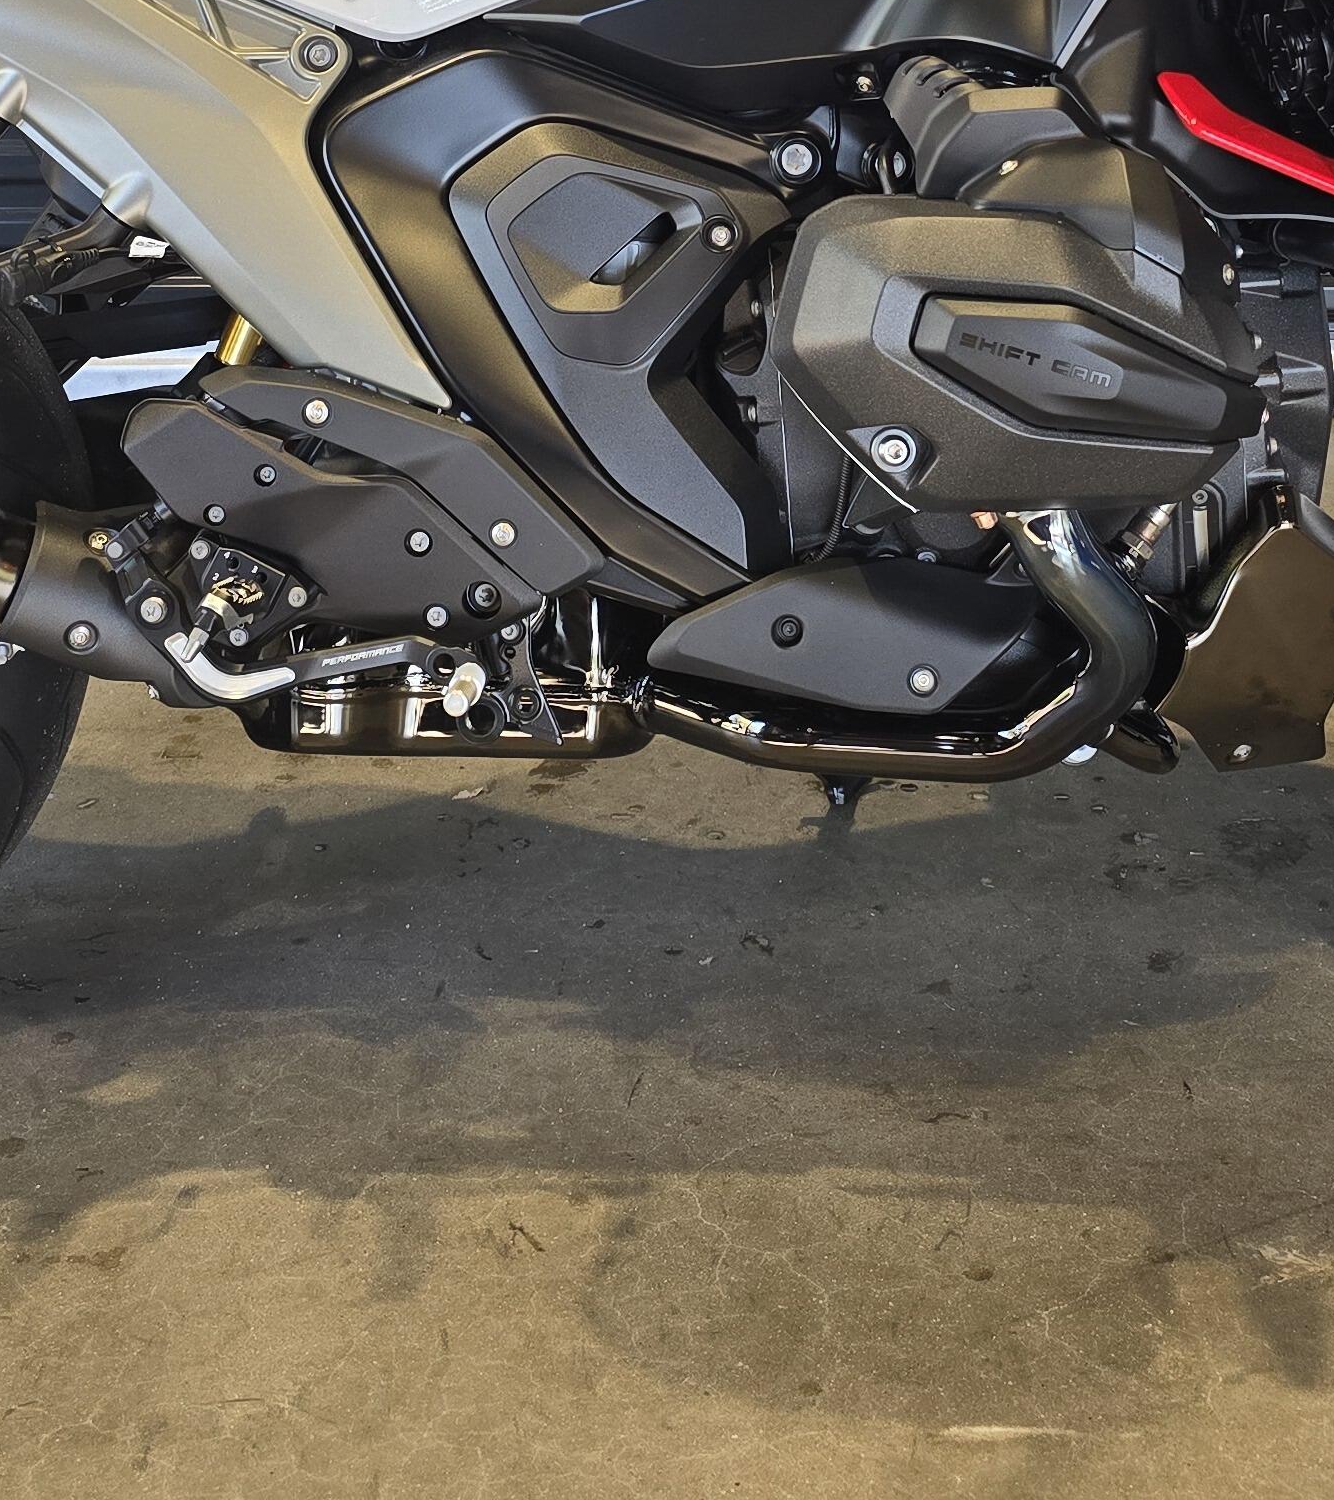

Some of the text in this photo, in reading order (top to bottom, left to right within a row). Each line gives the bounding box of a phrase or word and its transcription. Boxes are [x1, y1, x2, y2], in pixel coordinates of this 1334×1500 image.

[959, 332, 1113, 388] SHIFT CAM
[212, 572, 220, 581] 2
[321, 643, 405, 668] PERFORMANCE
